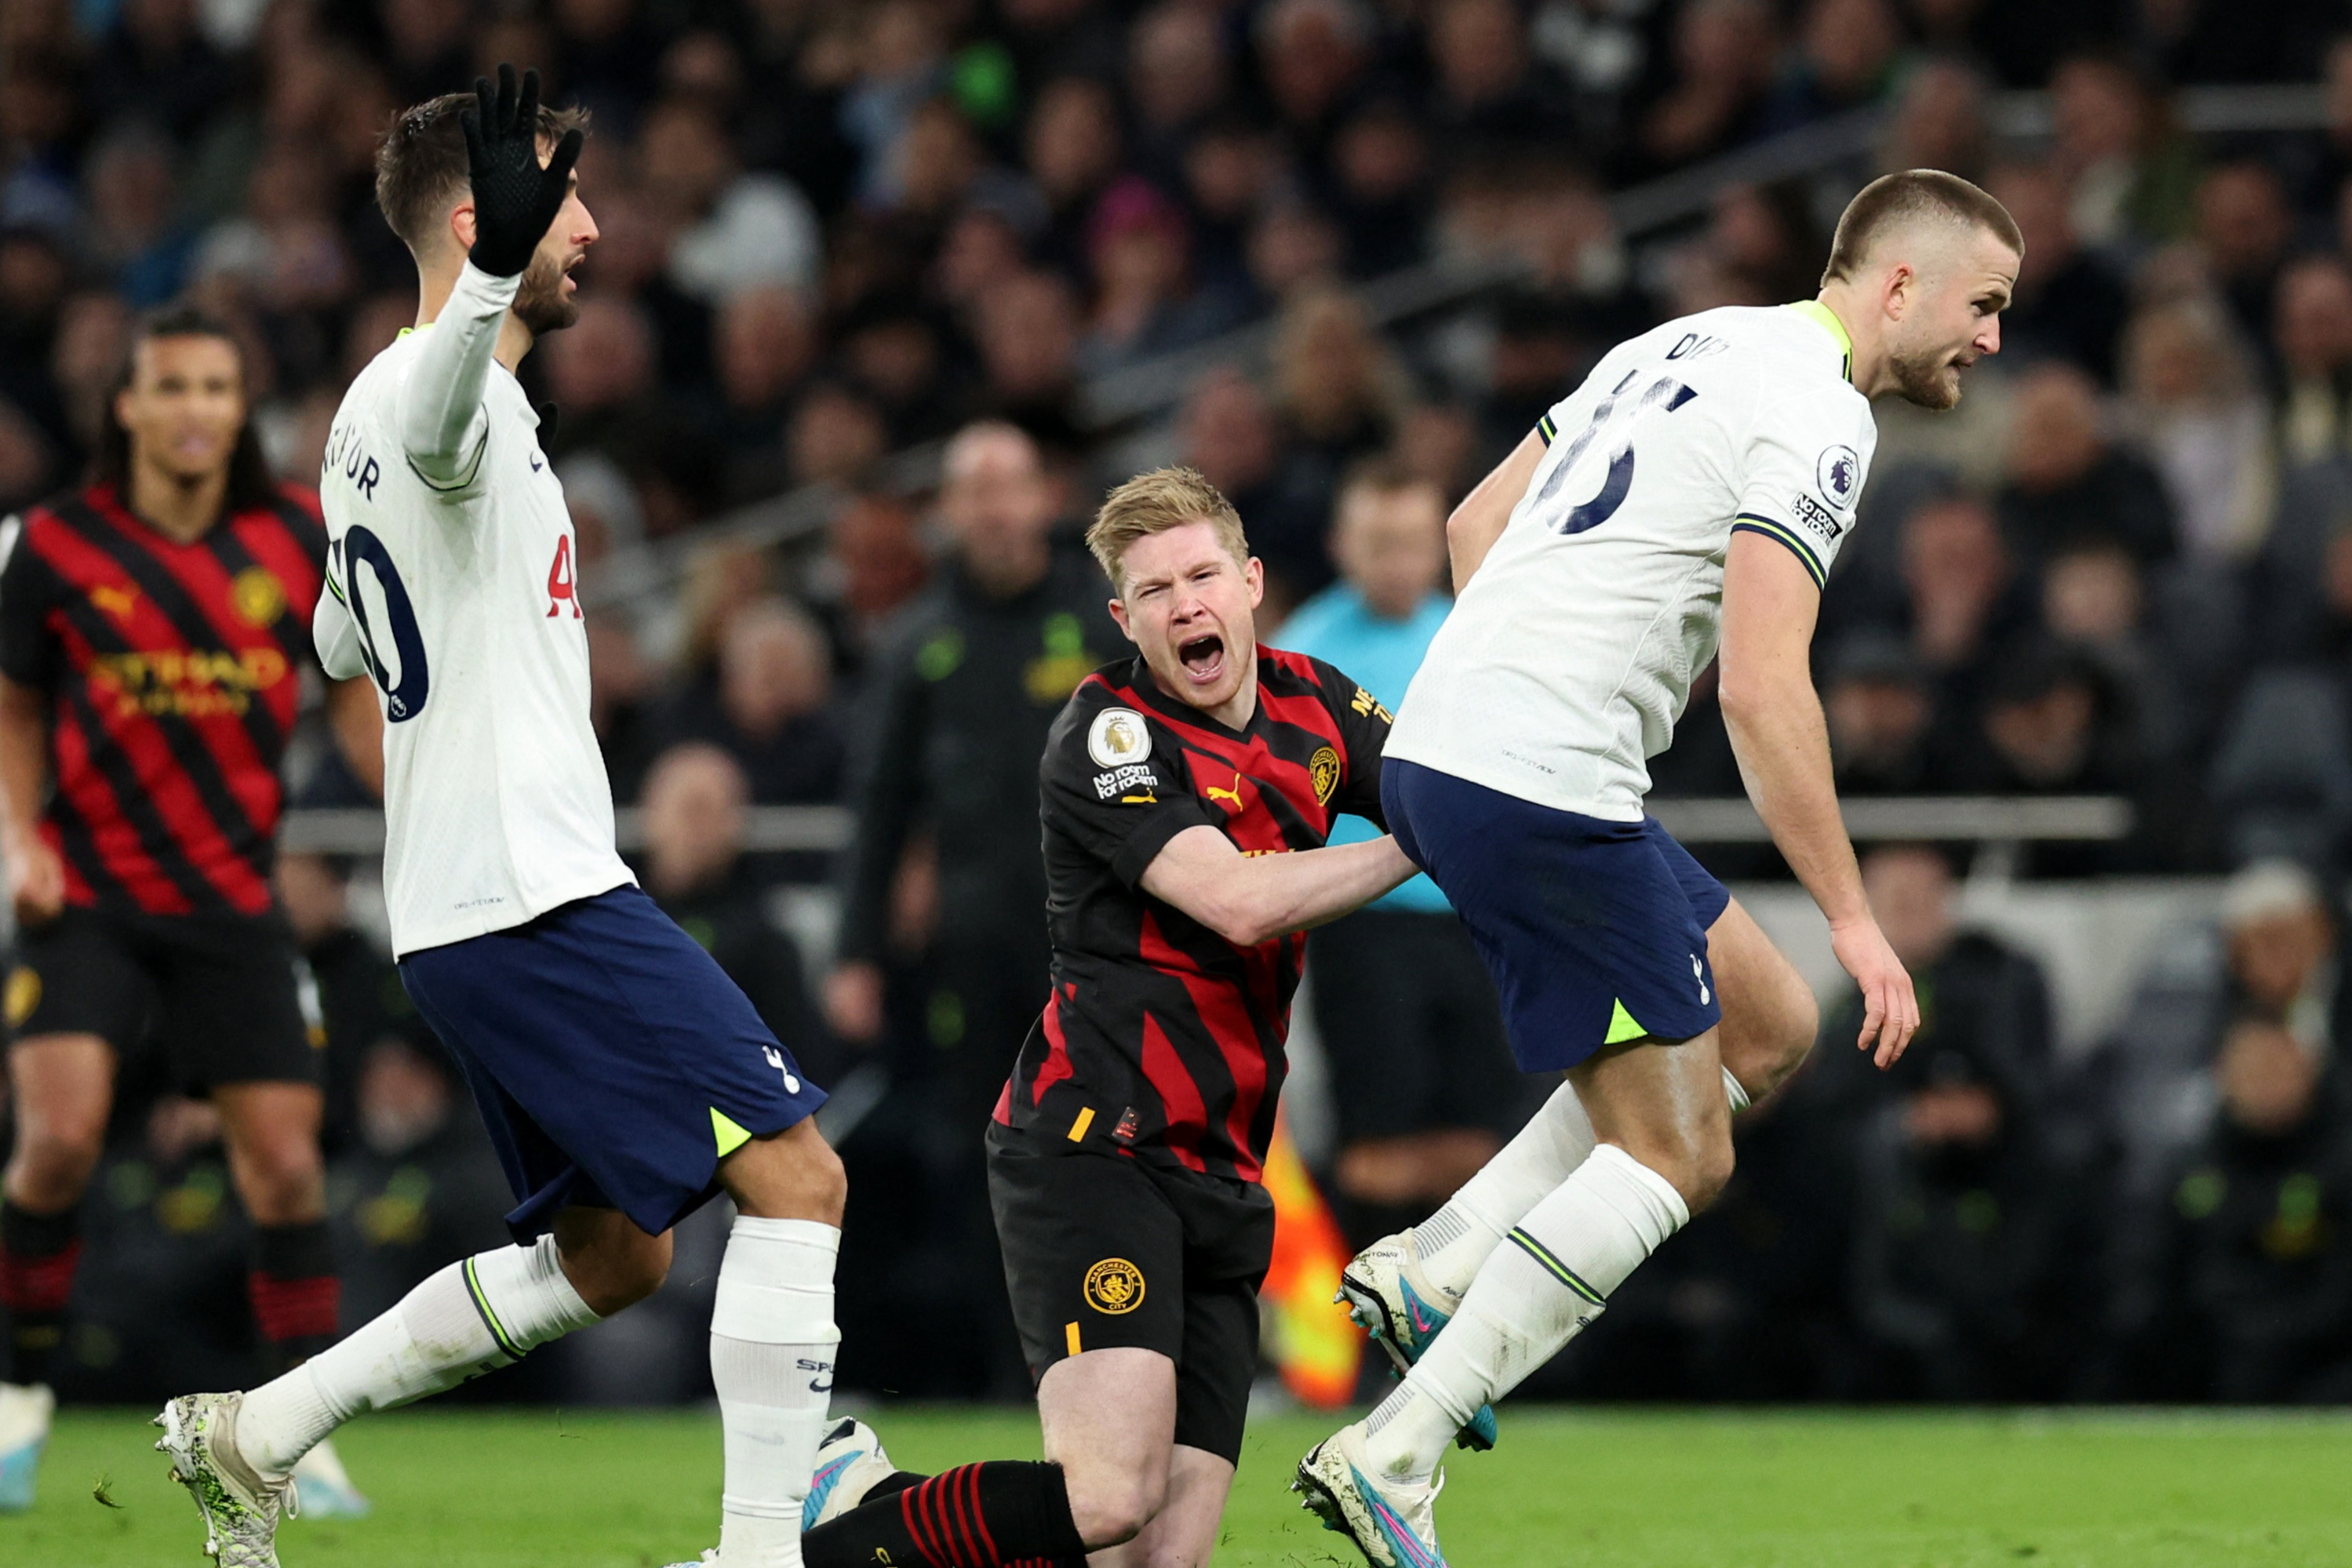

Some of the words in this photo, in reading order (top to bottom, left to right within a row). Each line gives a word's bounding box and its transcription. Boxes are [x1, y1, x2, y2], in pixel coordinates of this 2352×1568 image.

[1526, 369, 1698, 535] 15
[1093, 773, 1116, 789] No
[1115, 765, 1150, 780] room
[1098, 781, 1117, 799] for
[1090, 1262, 1137, 1283] MANCHESTER
